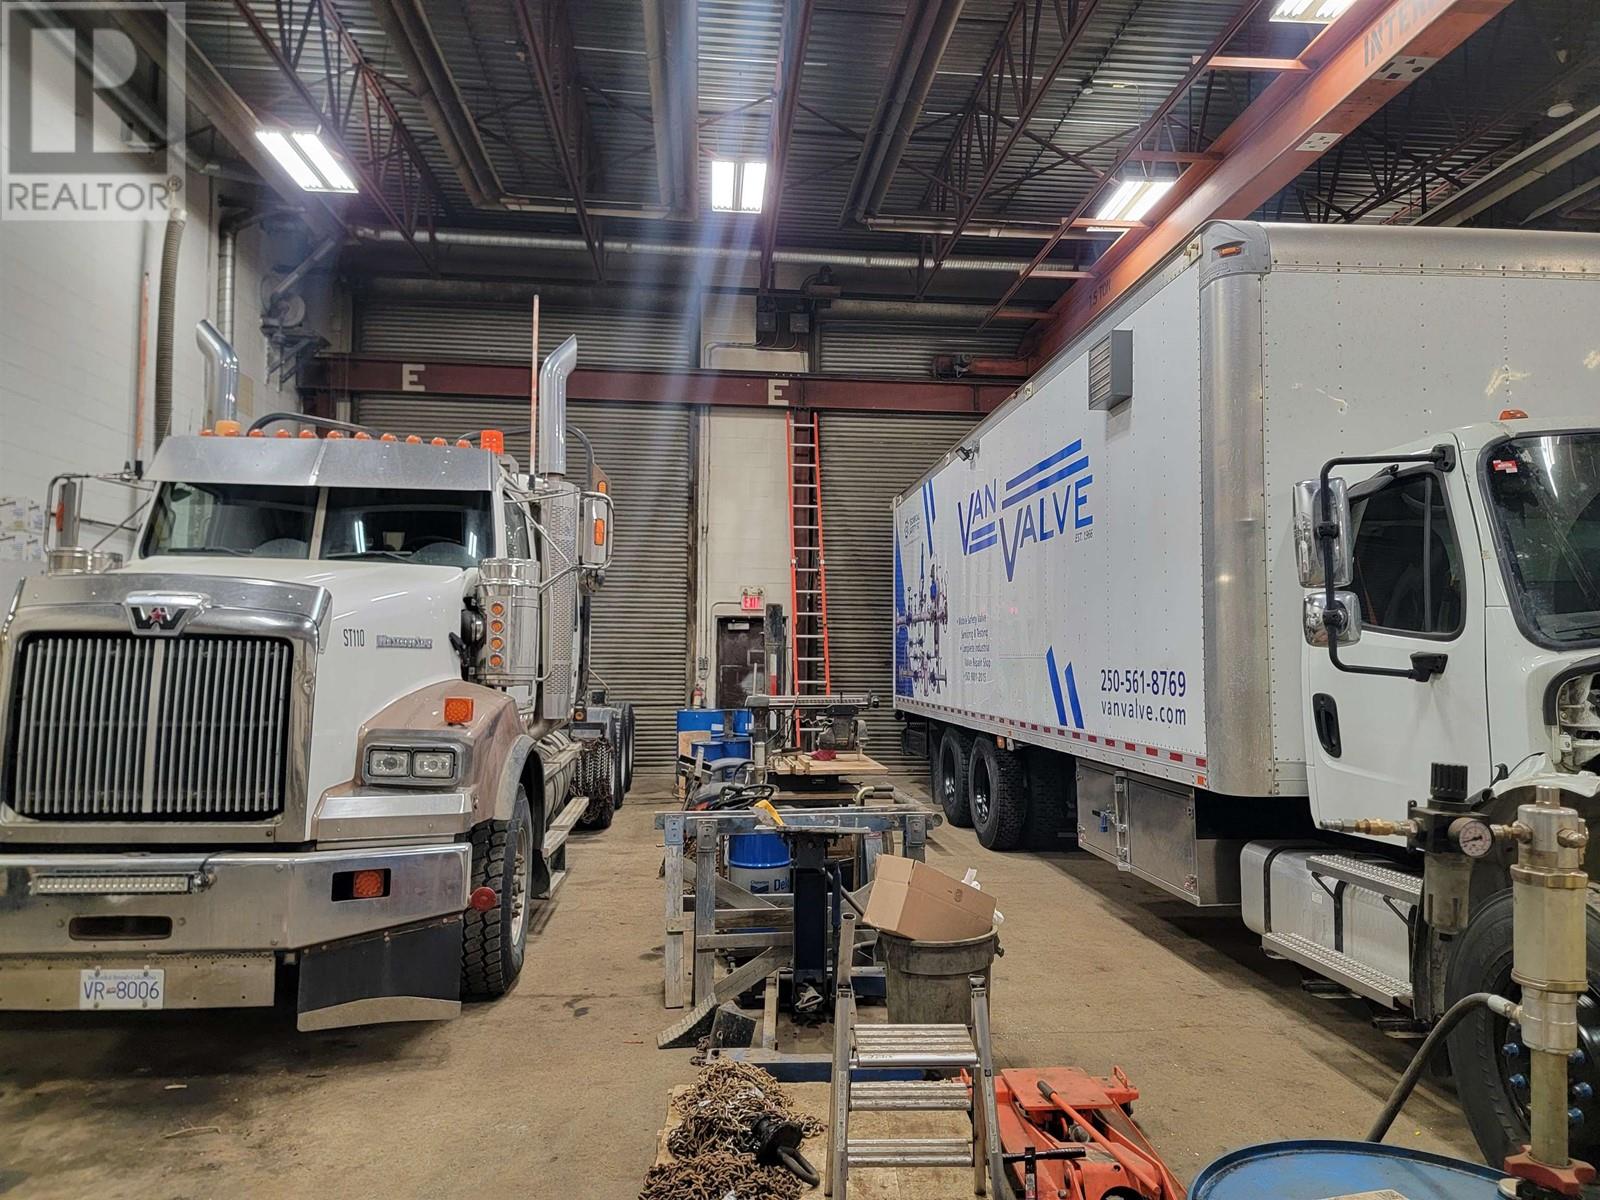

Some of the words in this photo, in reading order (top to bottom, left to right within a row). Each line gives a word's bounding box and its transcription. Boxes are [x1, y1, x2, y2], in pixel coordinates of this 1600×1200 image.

[402, 364, 425, 391] E
[768, 379, 789, 406] E
[957, 478, 997, 557] VAN
[999, 474, 1094, 583] VALVE
[343, 628, 365, 648] ST110
[1101, 669, 1186, 697] 250-561-8769
[1101, 697, 1186, 725] vanvalve.com
